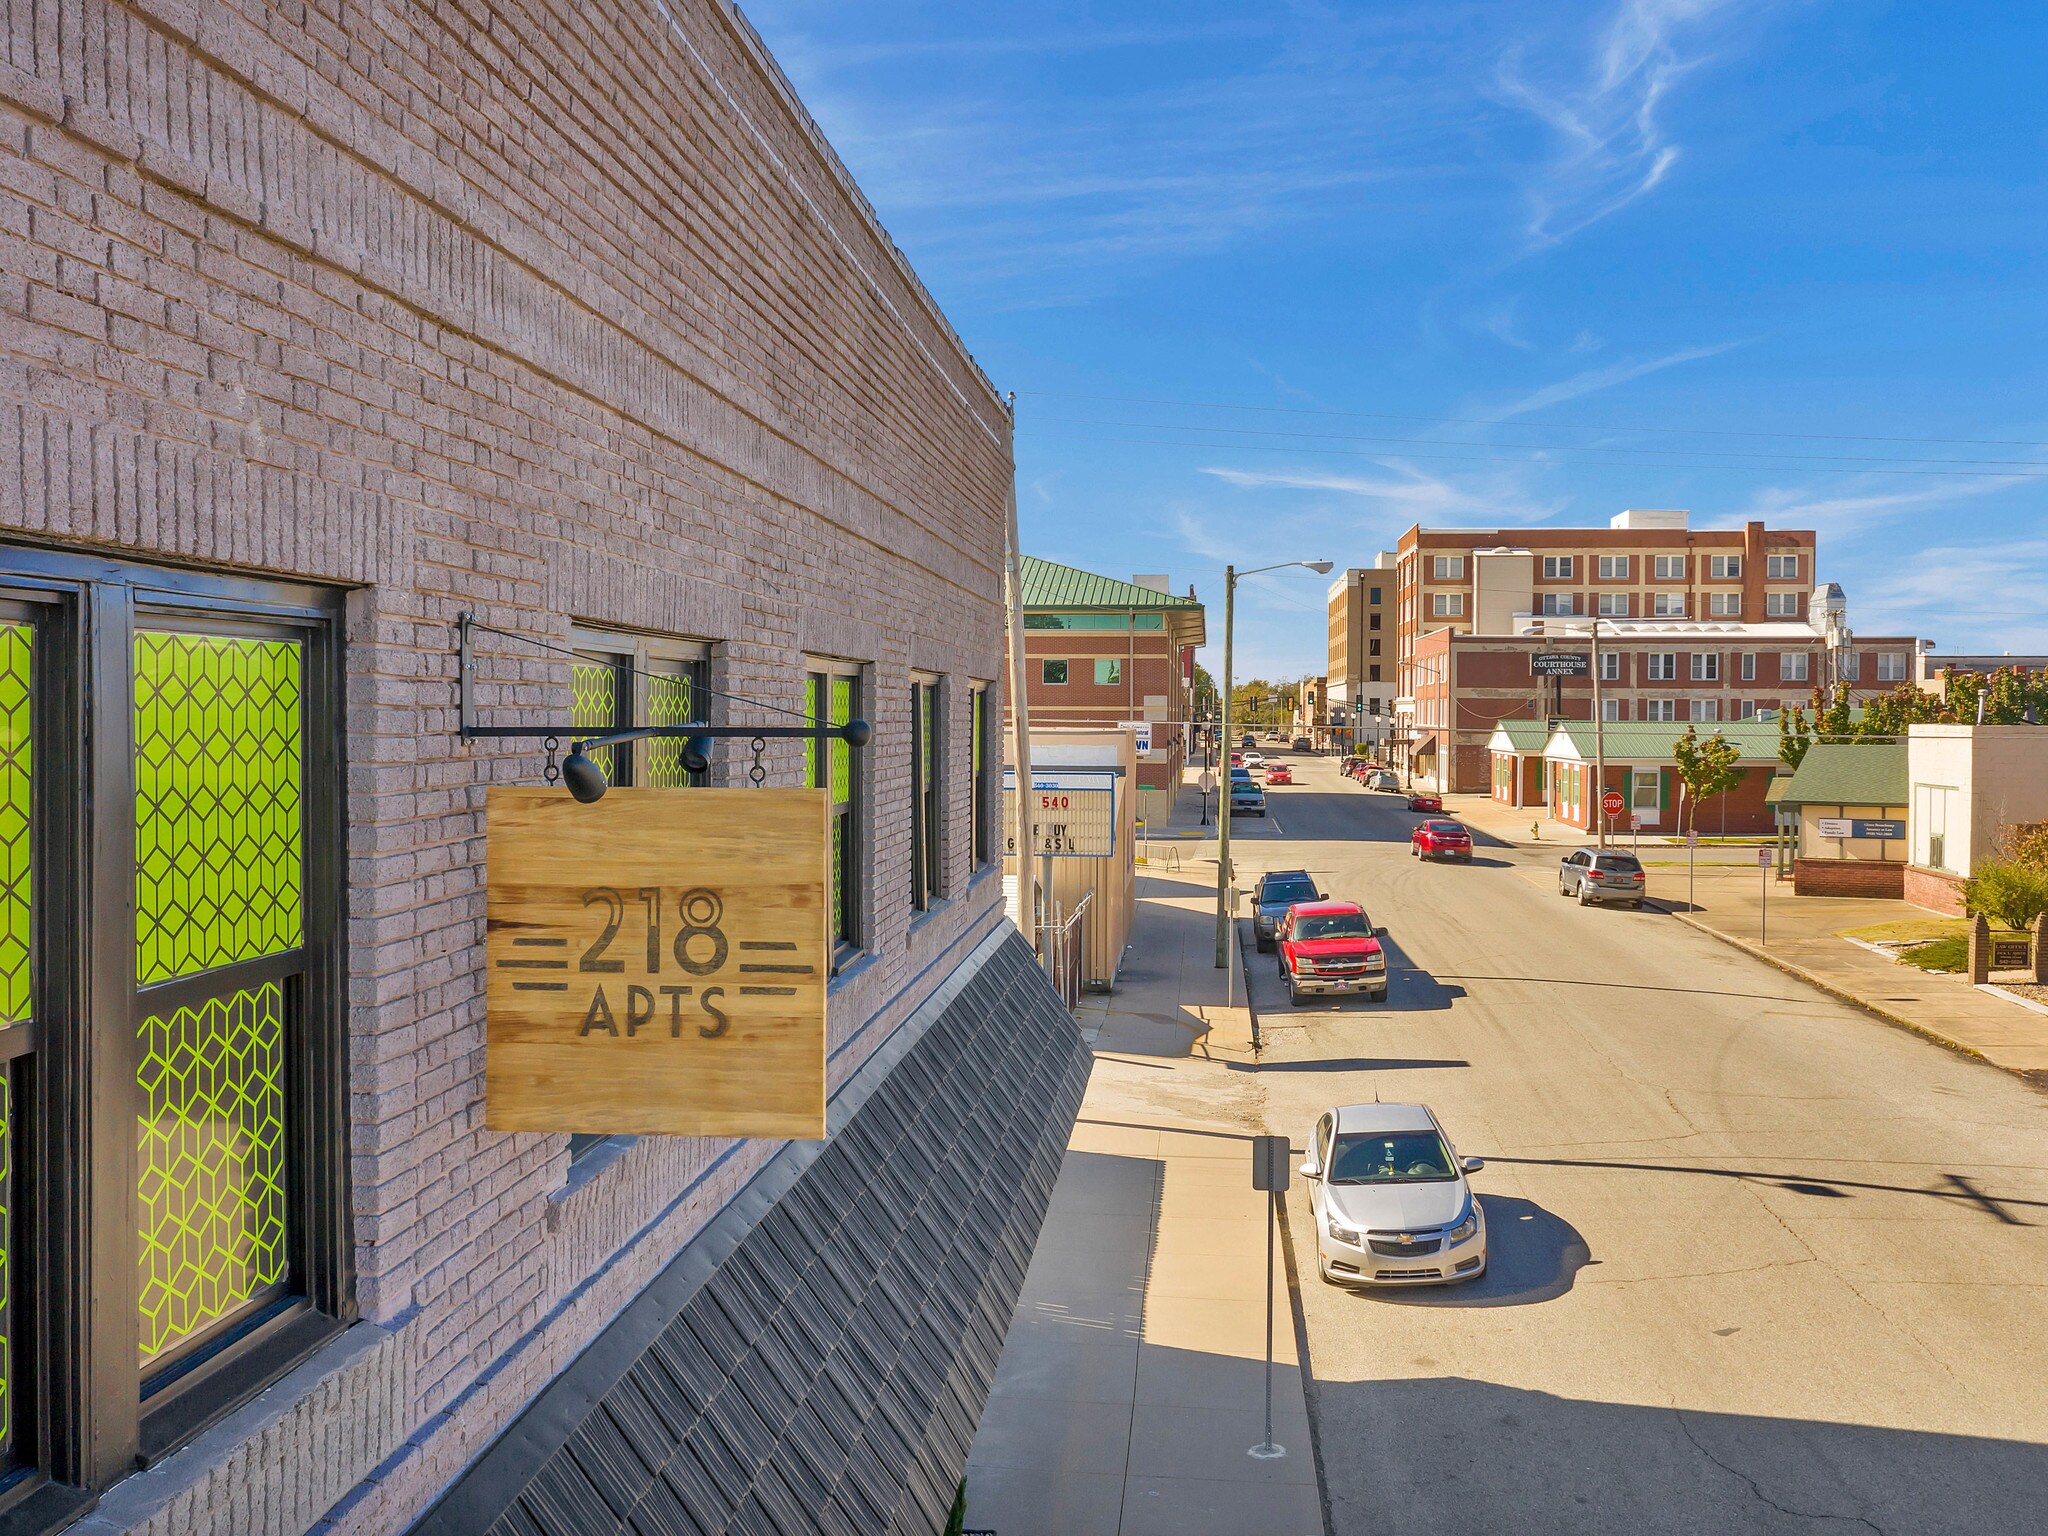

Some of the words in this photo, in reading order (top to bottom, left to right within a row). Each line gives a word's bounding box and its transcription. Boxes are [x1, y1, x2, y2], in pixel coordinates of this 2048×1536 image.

[1042, 796, 1069, 808] 540
[1603, 799, 1623, 808] STOP
[578, 886, 729, 976] 218
[578, 983, 728, 1039] APTS
